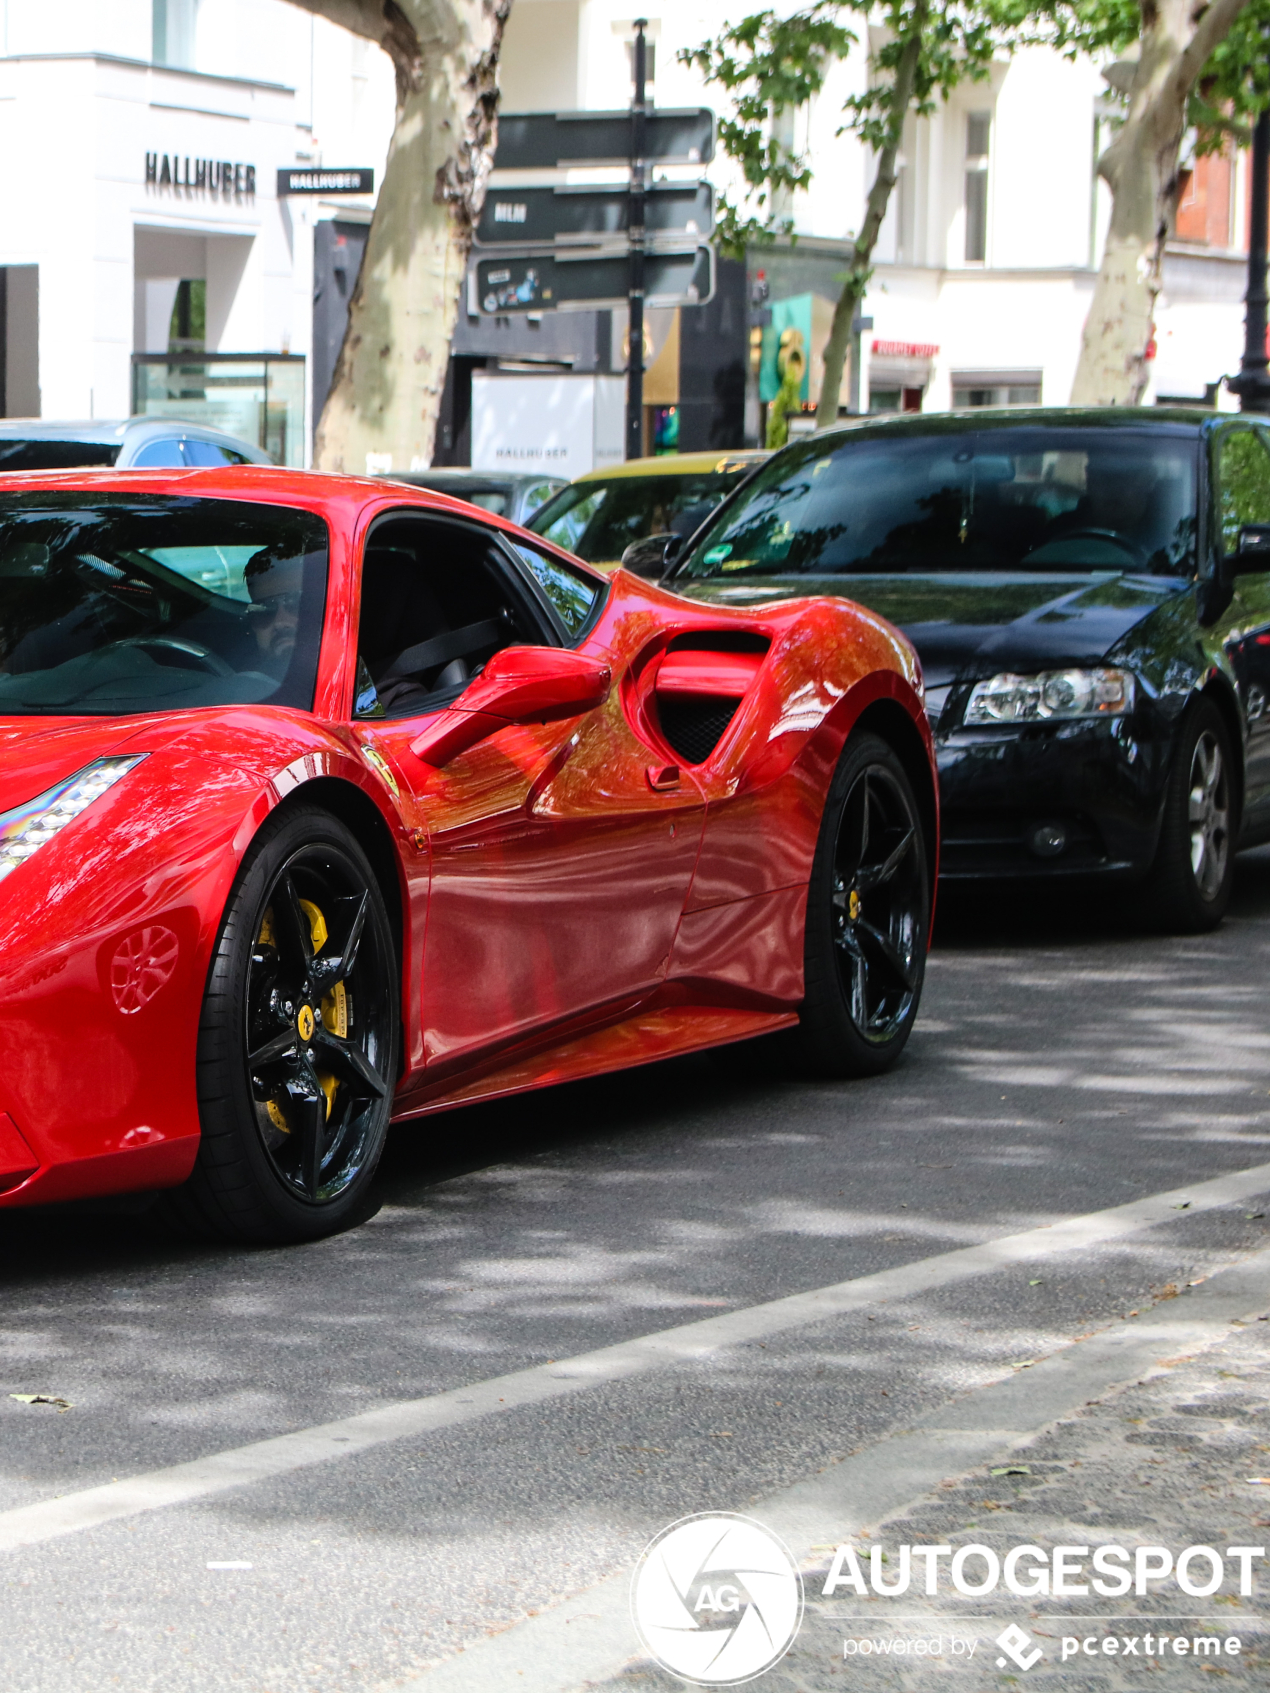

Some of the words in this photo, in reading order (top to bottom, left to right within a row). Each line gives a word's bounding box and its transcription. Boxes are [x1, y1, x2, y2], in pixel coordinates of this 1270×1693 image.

[145, 151, 256, 195] HALLHUBER
[289, 172, 362, 190] HALLHUBER
[495, 448, 569, 460] HALLHUBER
